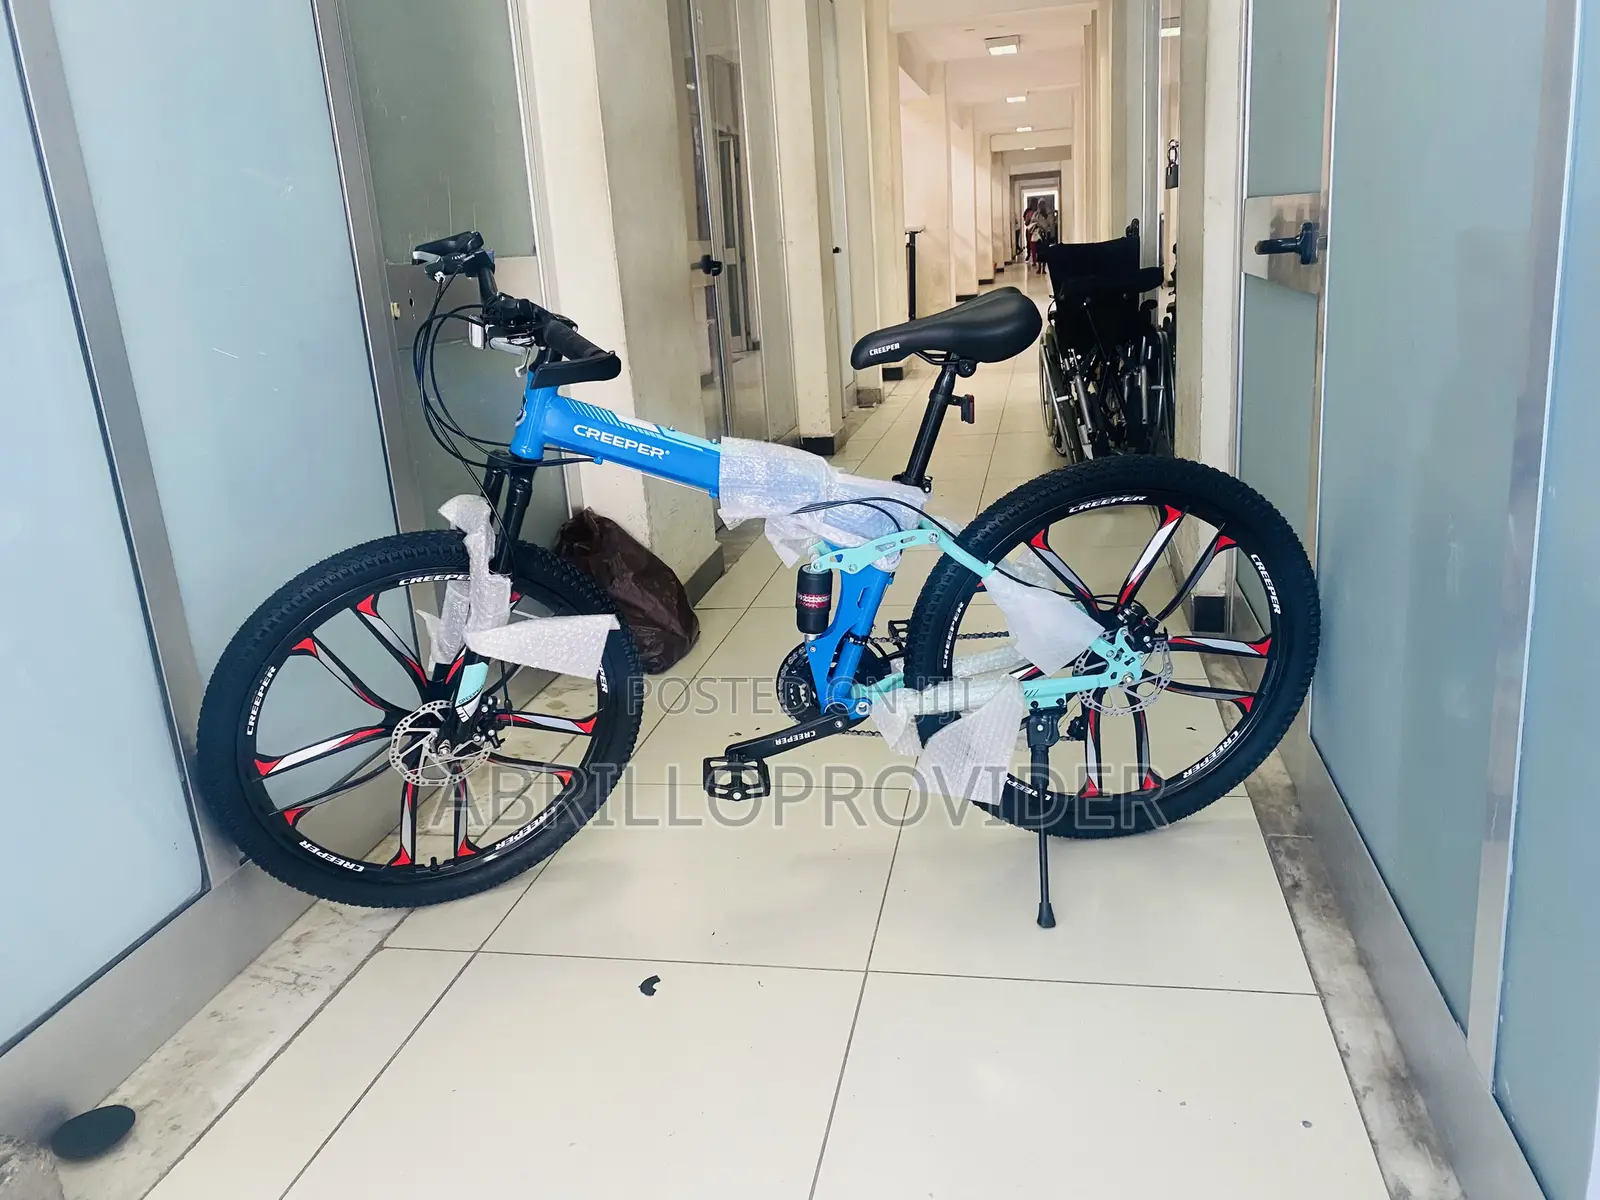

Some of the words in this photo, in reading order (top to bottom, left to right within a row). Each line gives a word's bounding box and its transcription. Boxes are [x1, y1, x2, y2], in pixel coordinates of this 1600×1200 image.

[869, 342, 900, 356] CREEPER
[1068, 495, 1147, 513] CREEPER
[398, 574, 471, 586] CREEPE
[1250, 554, 1281, 615] CREEPER
[943, 601, 964, 669] CREEPER
[246, 665, 276, 736] CREEPER
[775, 730, 816, 746] CREEPER
[1182, 730, 1239, 779] CREEPER
[495, 806, 556, 850] CREEPER
[298, 840, 365, 872] CREEPER
